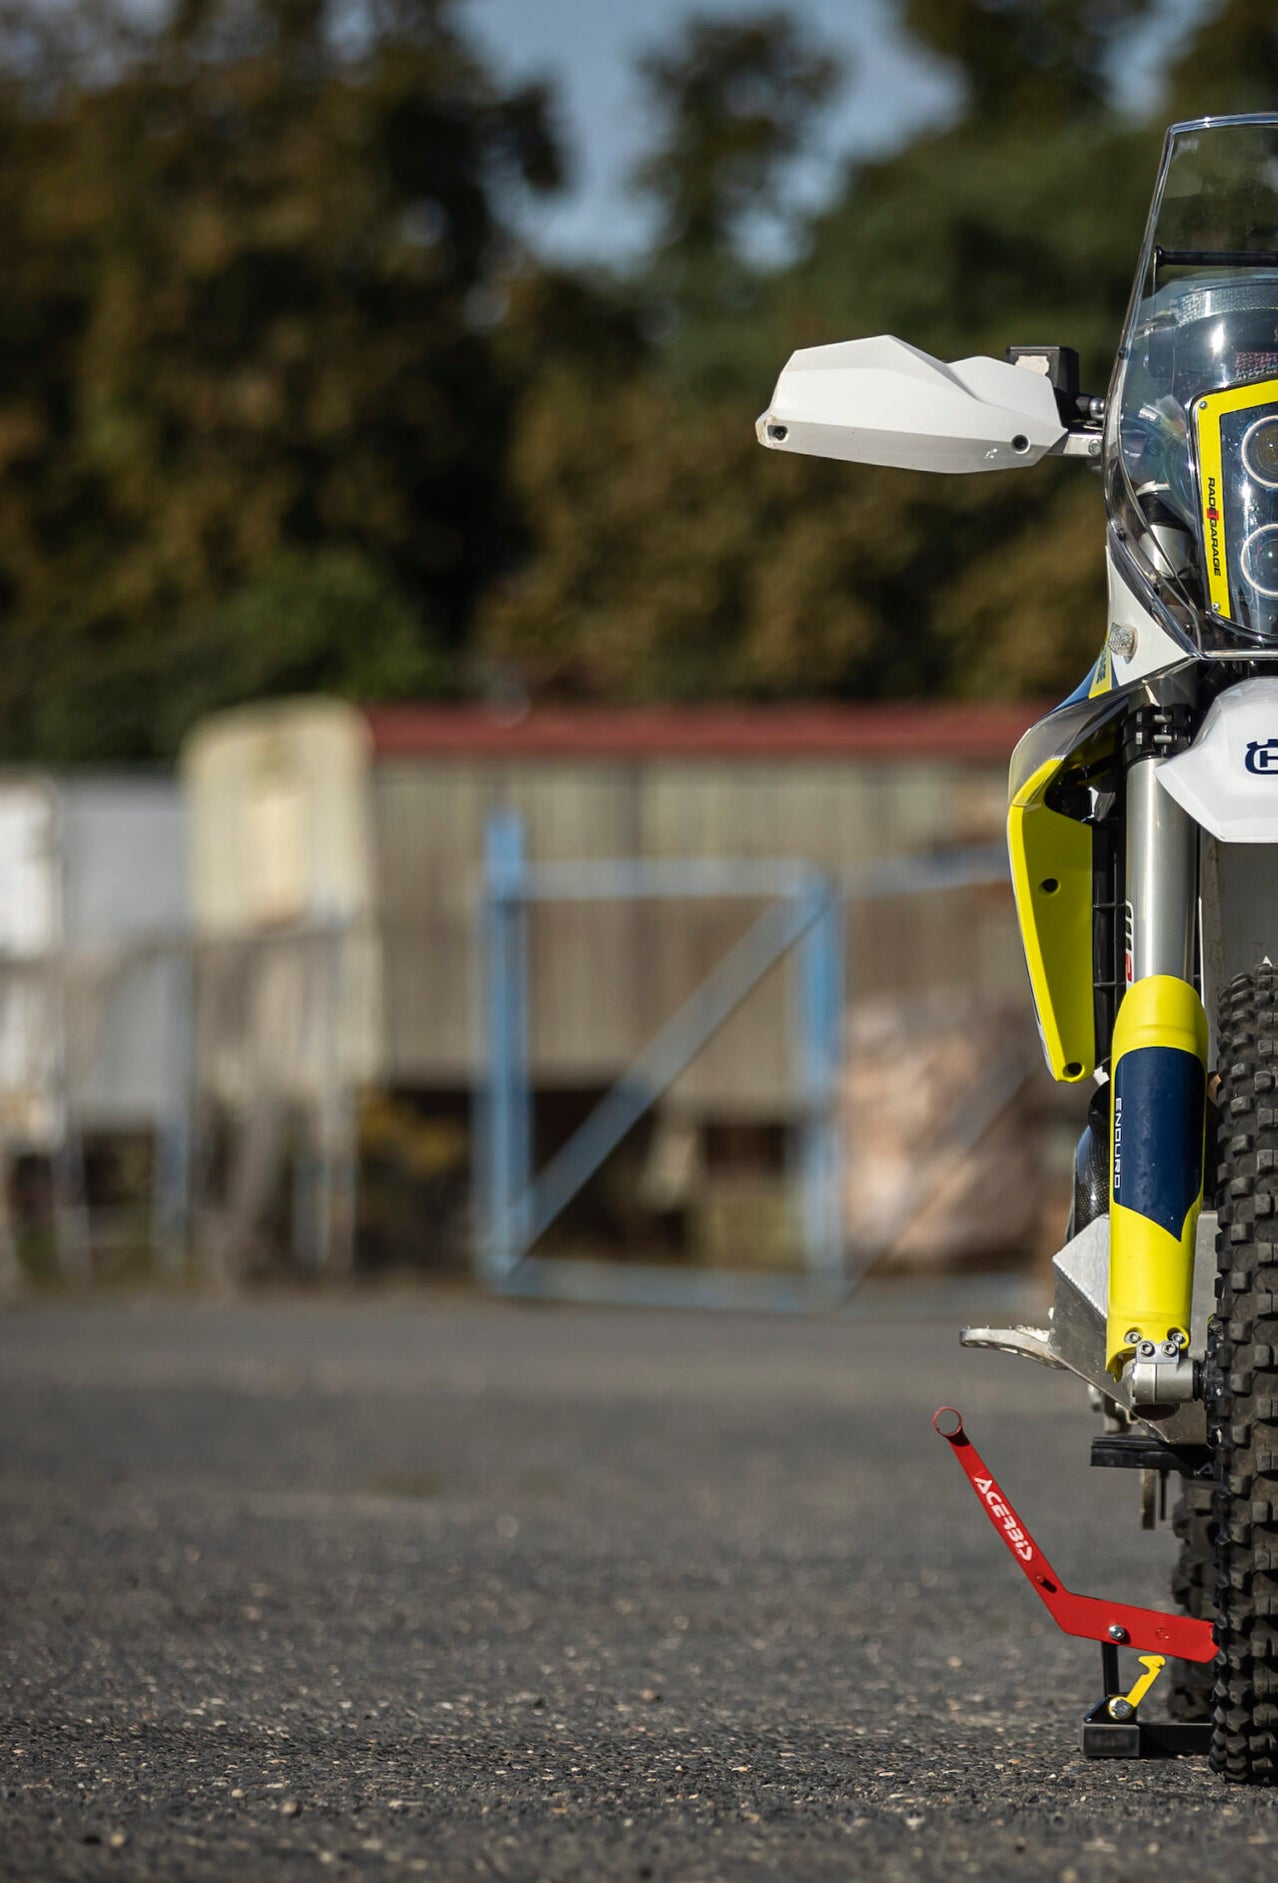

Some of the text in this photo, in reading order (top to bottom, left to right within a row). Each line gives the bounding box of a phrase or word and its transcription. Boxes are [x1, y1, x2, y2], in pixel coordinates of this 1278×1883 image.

[1210, 518, 1221, 577] GARAGE
[1114, 1097, 1122, 1189] ENDURO
[974, 1476, 1034, 1562] ACERBIS
